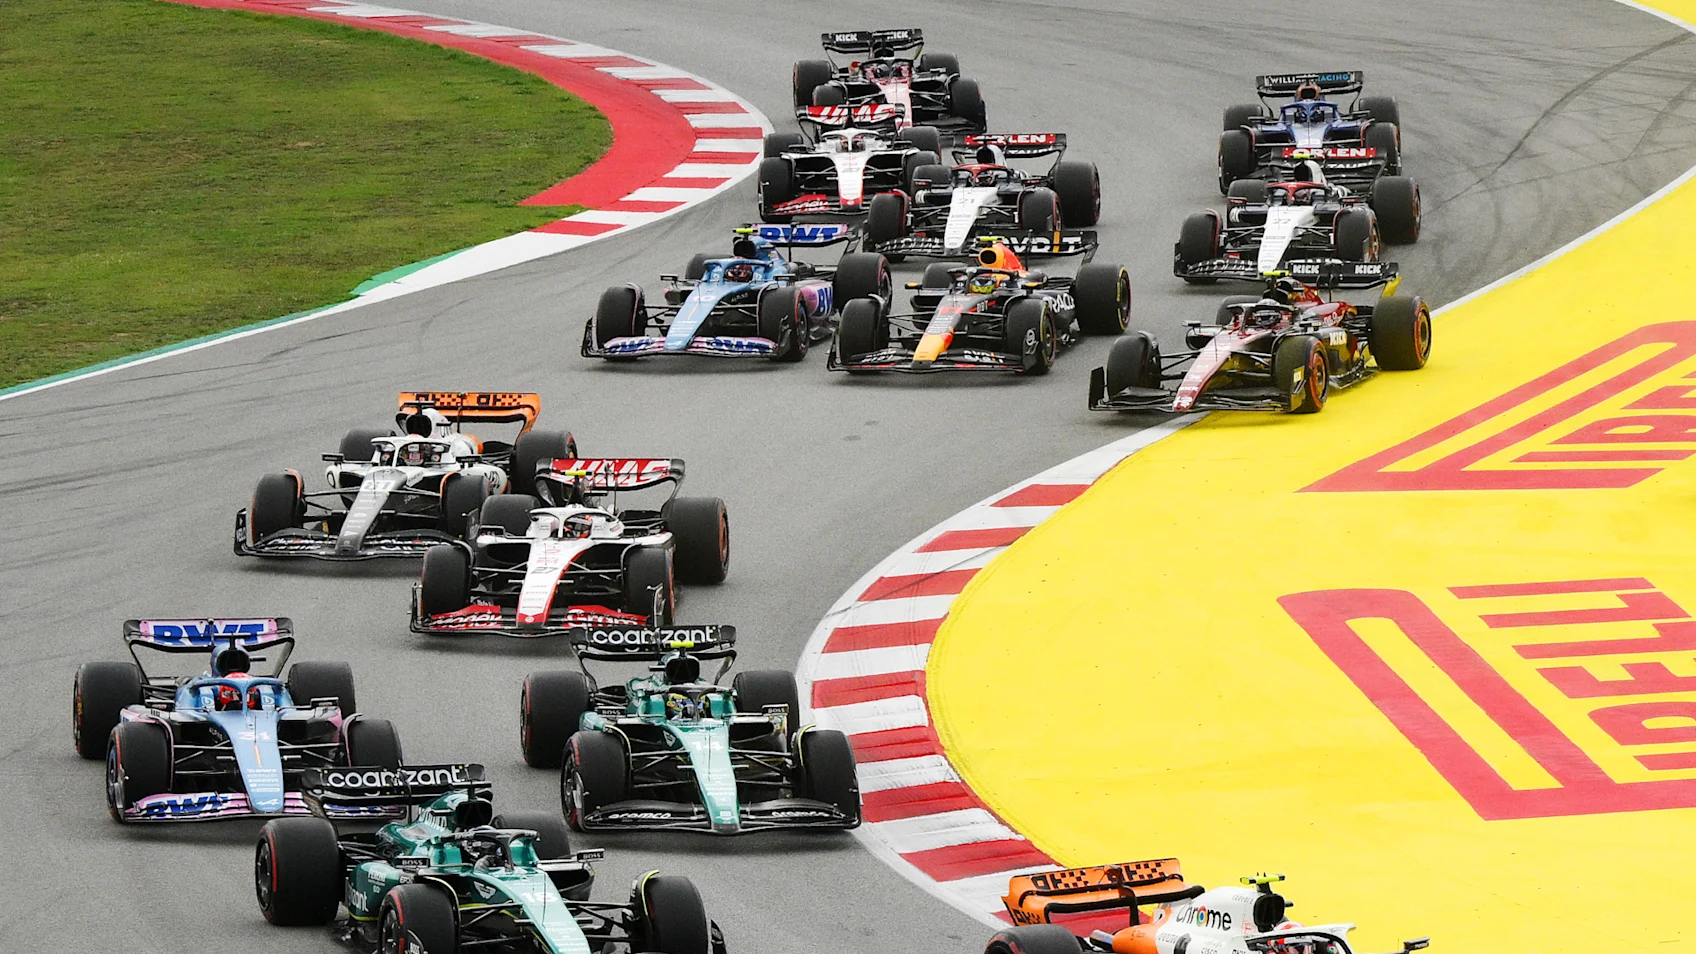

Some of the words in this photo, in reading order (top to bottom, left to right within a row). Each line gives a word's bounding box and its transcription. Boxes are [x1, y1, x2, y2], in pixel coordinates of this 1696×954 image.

[836, 33, 858, 41] KICK
[887, 31, 909, 39] ICK
[760, 227, 838, 242] BWT
[1002, 231, 1082, 253] YBIT
[1293, 264, 1320, 274] KICK
[1354, 264, 1382, 274] KICK
[152, 622, 266, 646] BWT
